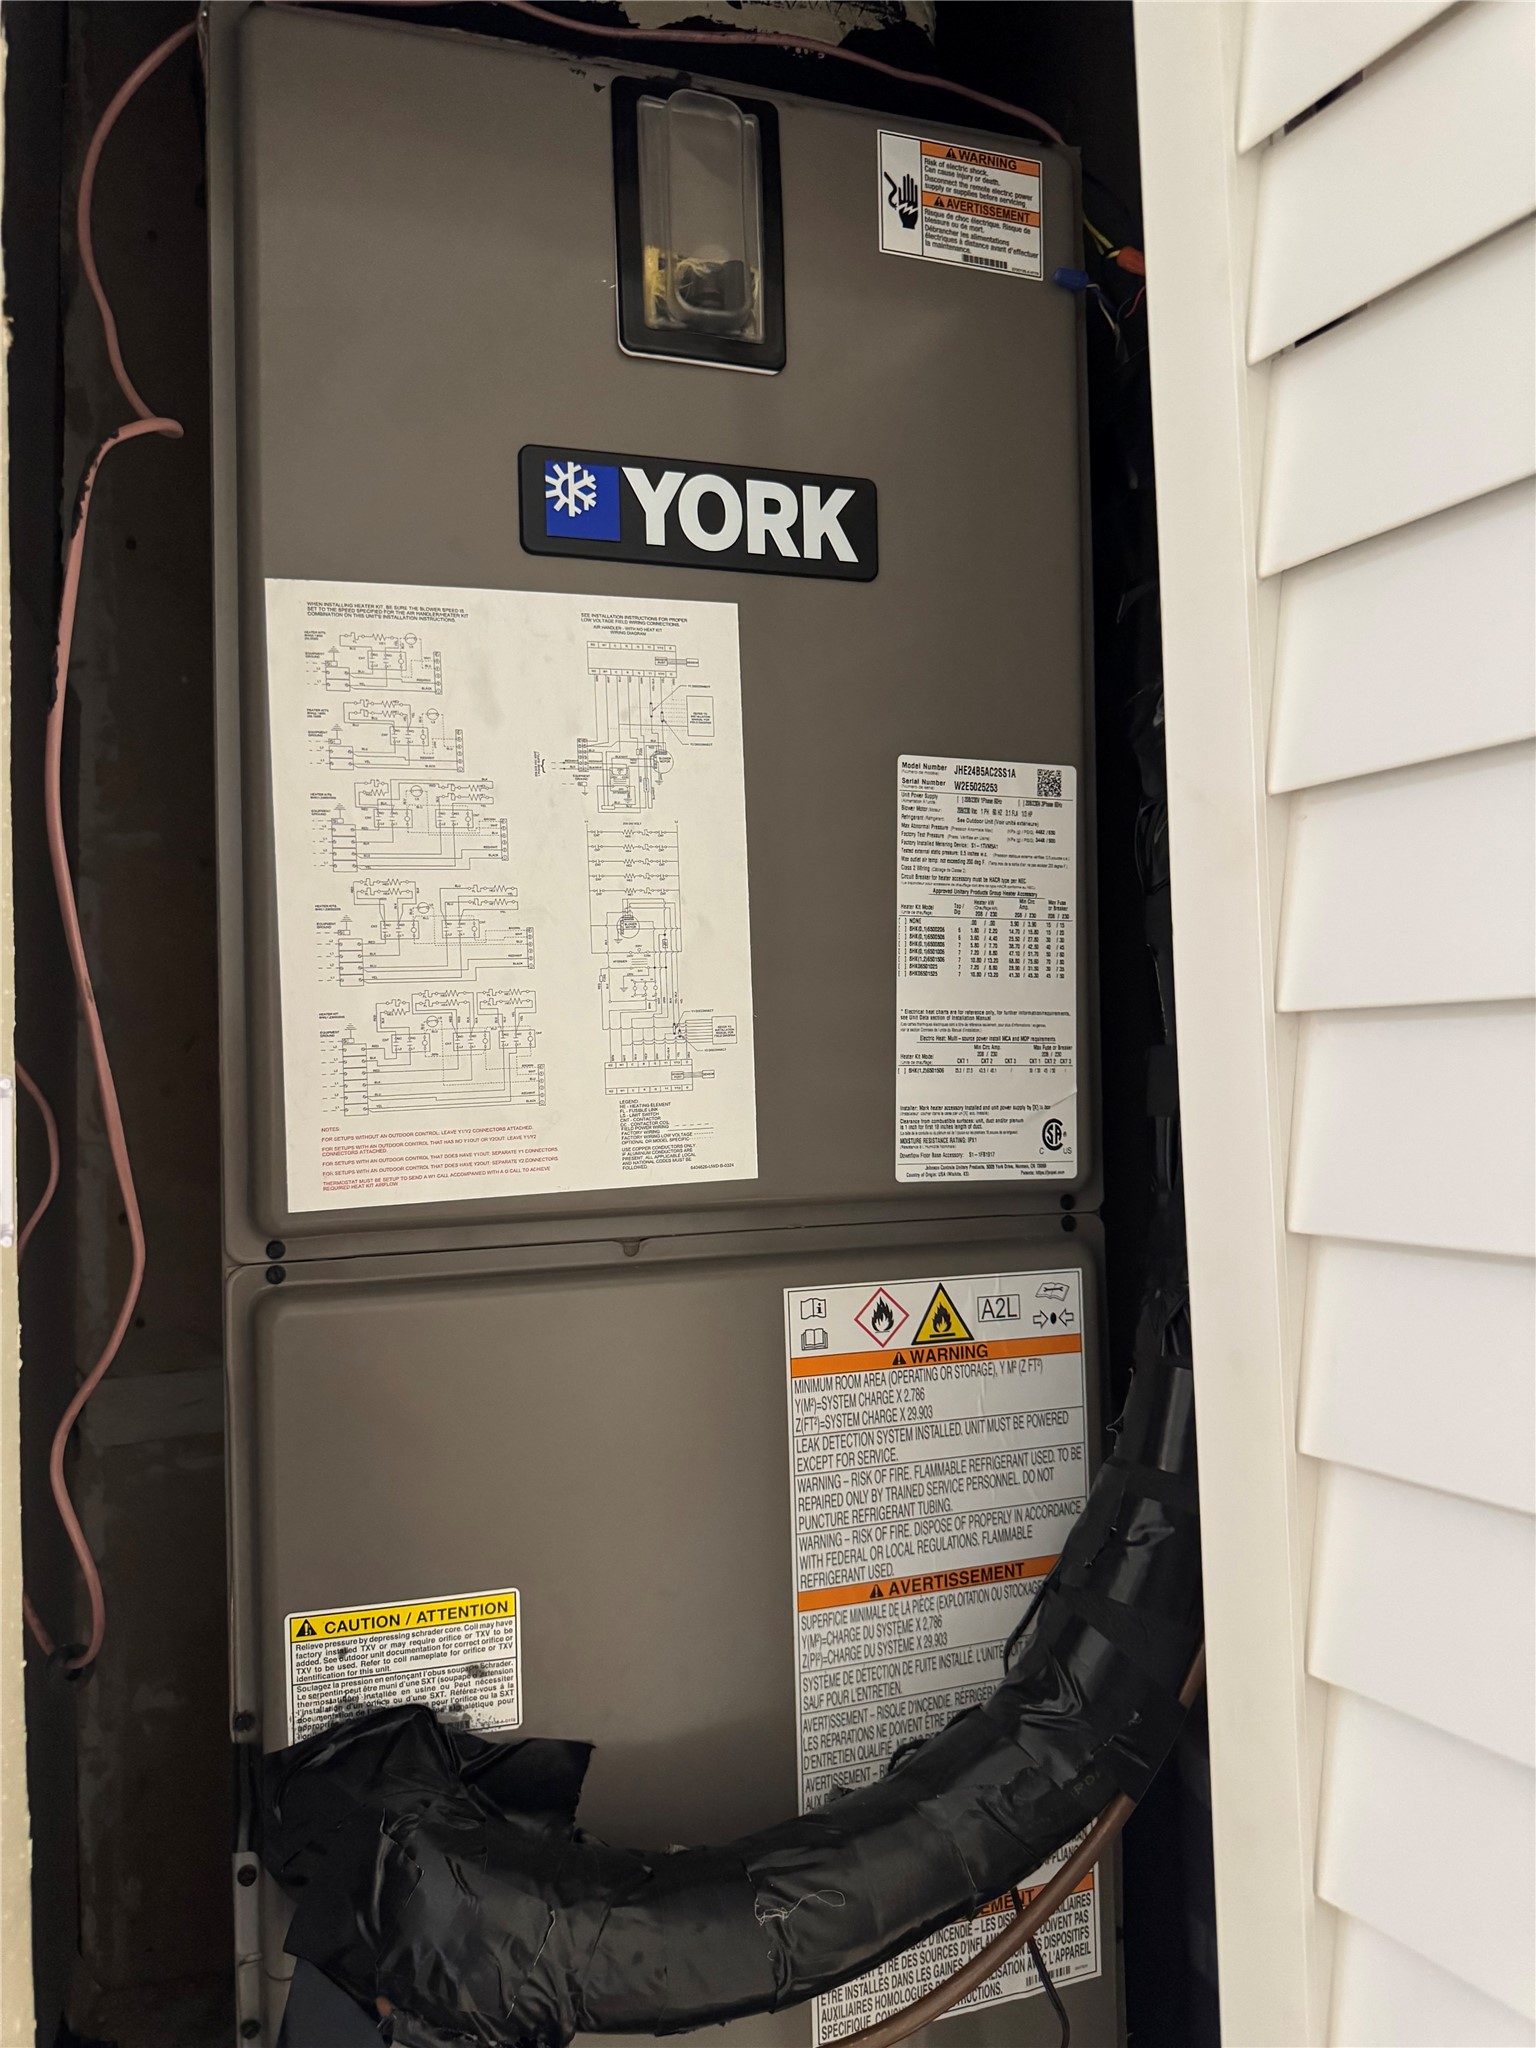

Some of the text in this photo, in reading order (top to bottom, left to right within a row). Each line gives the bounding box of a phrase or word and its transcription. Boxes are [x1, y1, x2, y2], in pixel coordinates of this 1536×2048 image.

[959, 150, 1016, 170] WARNING
[946, 198, 1029, 223] AVERTISSEMENT
[621, 466, 859, 563] YORK
[981, 1295, 1018, 1319] A2L
[910, 1344, 987, 1363] WARNING
[794, 1376, 832, 1393] MINIMUM
[835, 1374, 861, 1390] ROOM
[863, 1371, 886, 1387] AREA
[888, 1367, 938, 1389] (OPERATING
[940, 1366, 952, 1380] OR
[999, 1361, 1004, 1374] Y
[1018, 1359, 1026, 1377] (Z
[858, 1390, 894, 1407] CHARGE
[896, 1390, 902, 1402] X
[904, 1388, 924, 1402] 2.786
[861, 1409, 897, 1425] CHARGE
[900, 1409, 905, 1421] X
[907, 1406, 933, 1421] 29.903
[796, 1410, 1069, 1453] LEAK DETECTION SYSTEM INSTALLED. UNIT MUST BE POWERED
[797, 1448, 898, 1472] EXCEPT FOR SERVICE.
[797, 1474, 840, 1492] WARNING
[851, 1470, 871, 1486] RISK
[874, 1469, 886, 1484] OF
[889, 1466, 911, 1482] FIRE.
[914, 1460, 966, 1479] FLAMMABLE
[968, 1452, 1028, 1473] REFRIGERANT
[1030, 1449, 1056, 1466] USED.
[1058, 1448, 1069, 1463] TO
[1069, 1446, 1082, 1461] BE
[798, 1468, 1055, 1511] REPAIRED ONLY BY TRAINED SERVICE PERSONNEL. DO NOT
[799, 1500, 952, 1530] PUNCTURE REFRIGERANT TUBING.
[799, 1532, 842, 1551] WARNING
[852, 1528, 872, 1544] RISK
[875, 1526, 886, 1541] OF
[889, 1523, 912, 1539] FIRE.
[914, 1518, 952, 1536] DISPOSE
[954, 1516, 965, 1531] OF
[968, 1510, 1011, 1529] PROPERLY
[1014, 1509, 1023, 1523] IN
[1024, 1501, 1082, 1522] ACCORDANCE
[800, 1525, 1033, 1569] WITH FEDERAL OR LOCAL REGULATIONS. FLAMMABLE
[800, 1563, 893, 1589] REFRIGERANT USED.
[889, 1563, 1024, 1597] AVERTISSEMENT
[324, 1613, 399, 1634] CAUTION
[417, 1601, 507, 1623] ATTENTION
[296, 1641, 323, 1651] Relieve
[324, 1639, 357, 1650] pressure
[358, 1636, 367, 1646] by
[369, 1631, 409, 1645] depressing
[411, 1628, 442, 1637] schrader
[464, 1624, 478, 1632] Coil
[479, 1622, 494, 1632] may
[296, 1656, 320, 1666] added.
[323, 1655, 337, 1663] See
[370, 1650, 384, 1658] unit
[386, 1643, 440, 1656] documentation
[454, 1639, 479, 1648] correct
[481, 1636, 503, 1645] orifice
[296, 1671, 345, 1682] identification
[375, 1666, 390, 1674] unit.
[1044, 1925, 1089, 1949] DISPOSITIFS
[1049, 1942, 1091, 1964] L'APPAREIL
